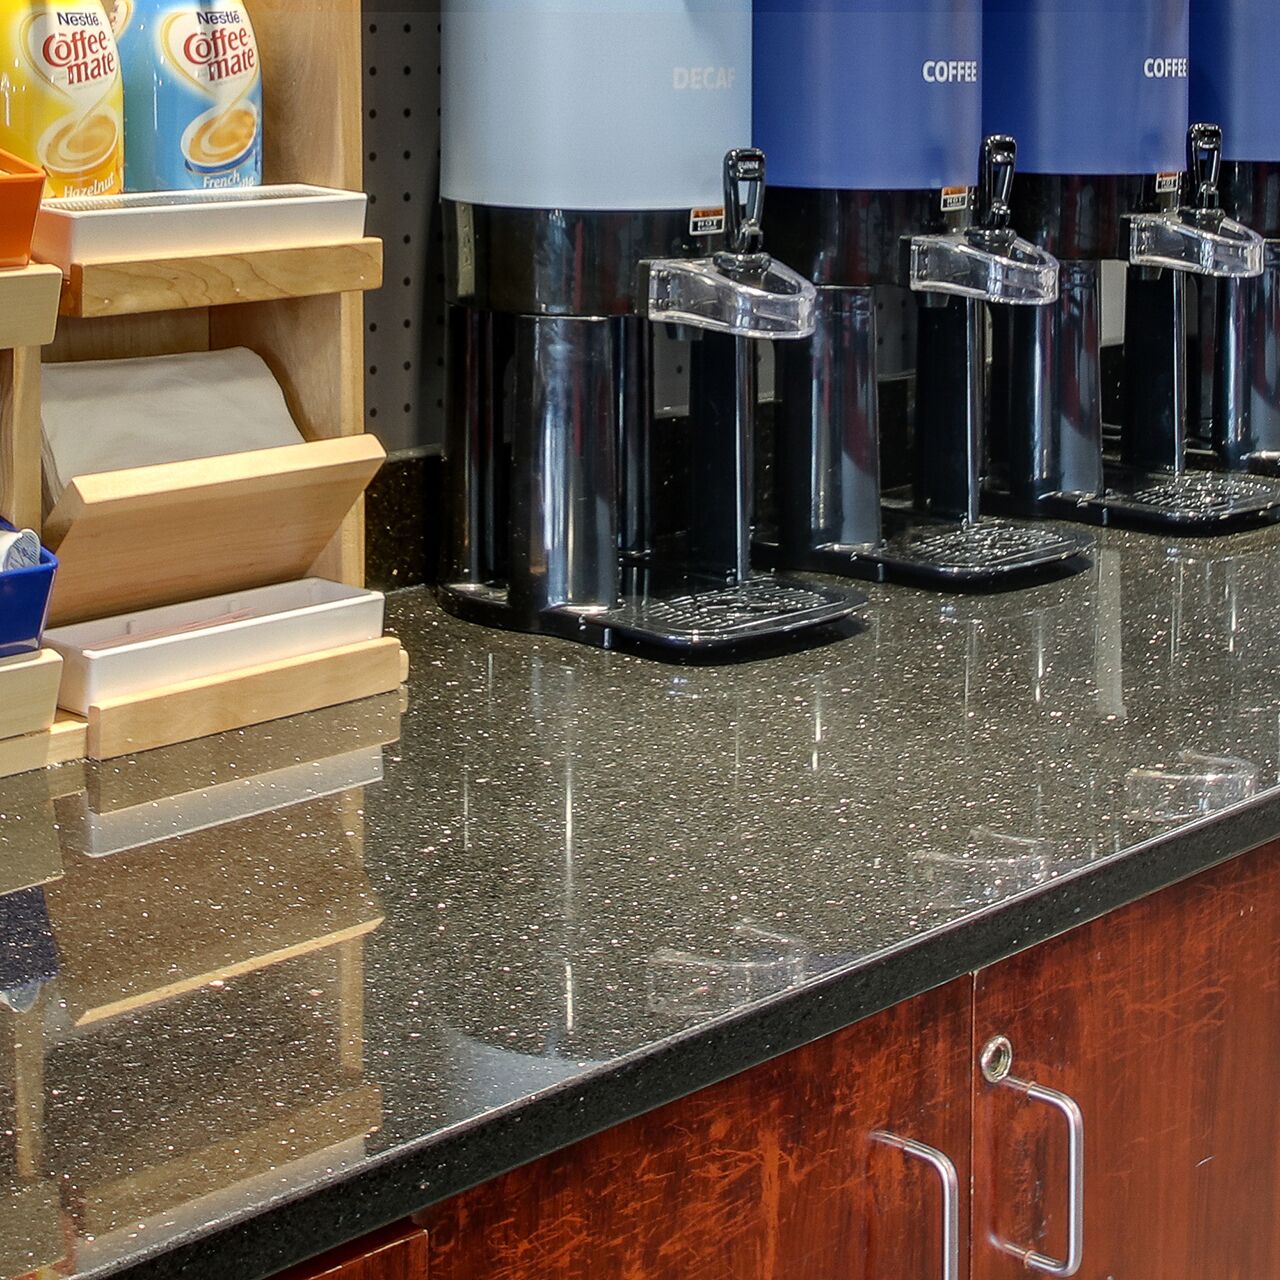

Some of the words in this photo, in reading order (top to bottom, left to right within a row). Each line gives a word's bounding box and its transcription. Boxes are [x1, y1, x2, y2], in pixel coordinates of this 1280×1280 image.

[67, 52, 115, 85] mate
[207, 48, 255, 81] mate
[922, 60, 977, 83] COFFEE
[1143, 57, 1187, 78] COFFEE
[672, 67, 736, 89] DECAF
[64, 172, 115, 198] Hazelnut
[203, 170, 240, 188] French
